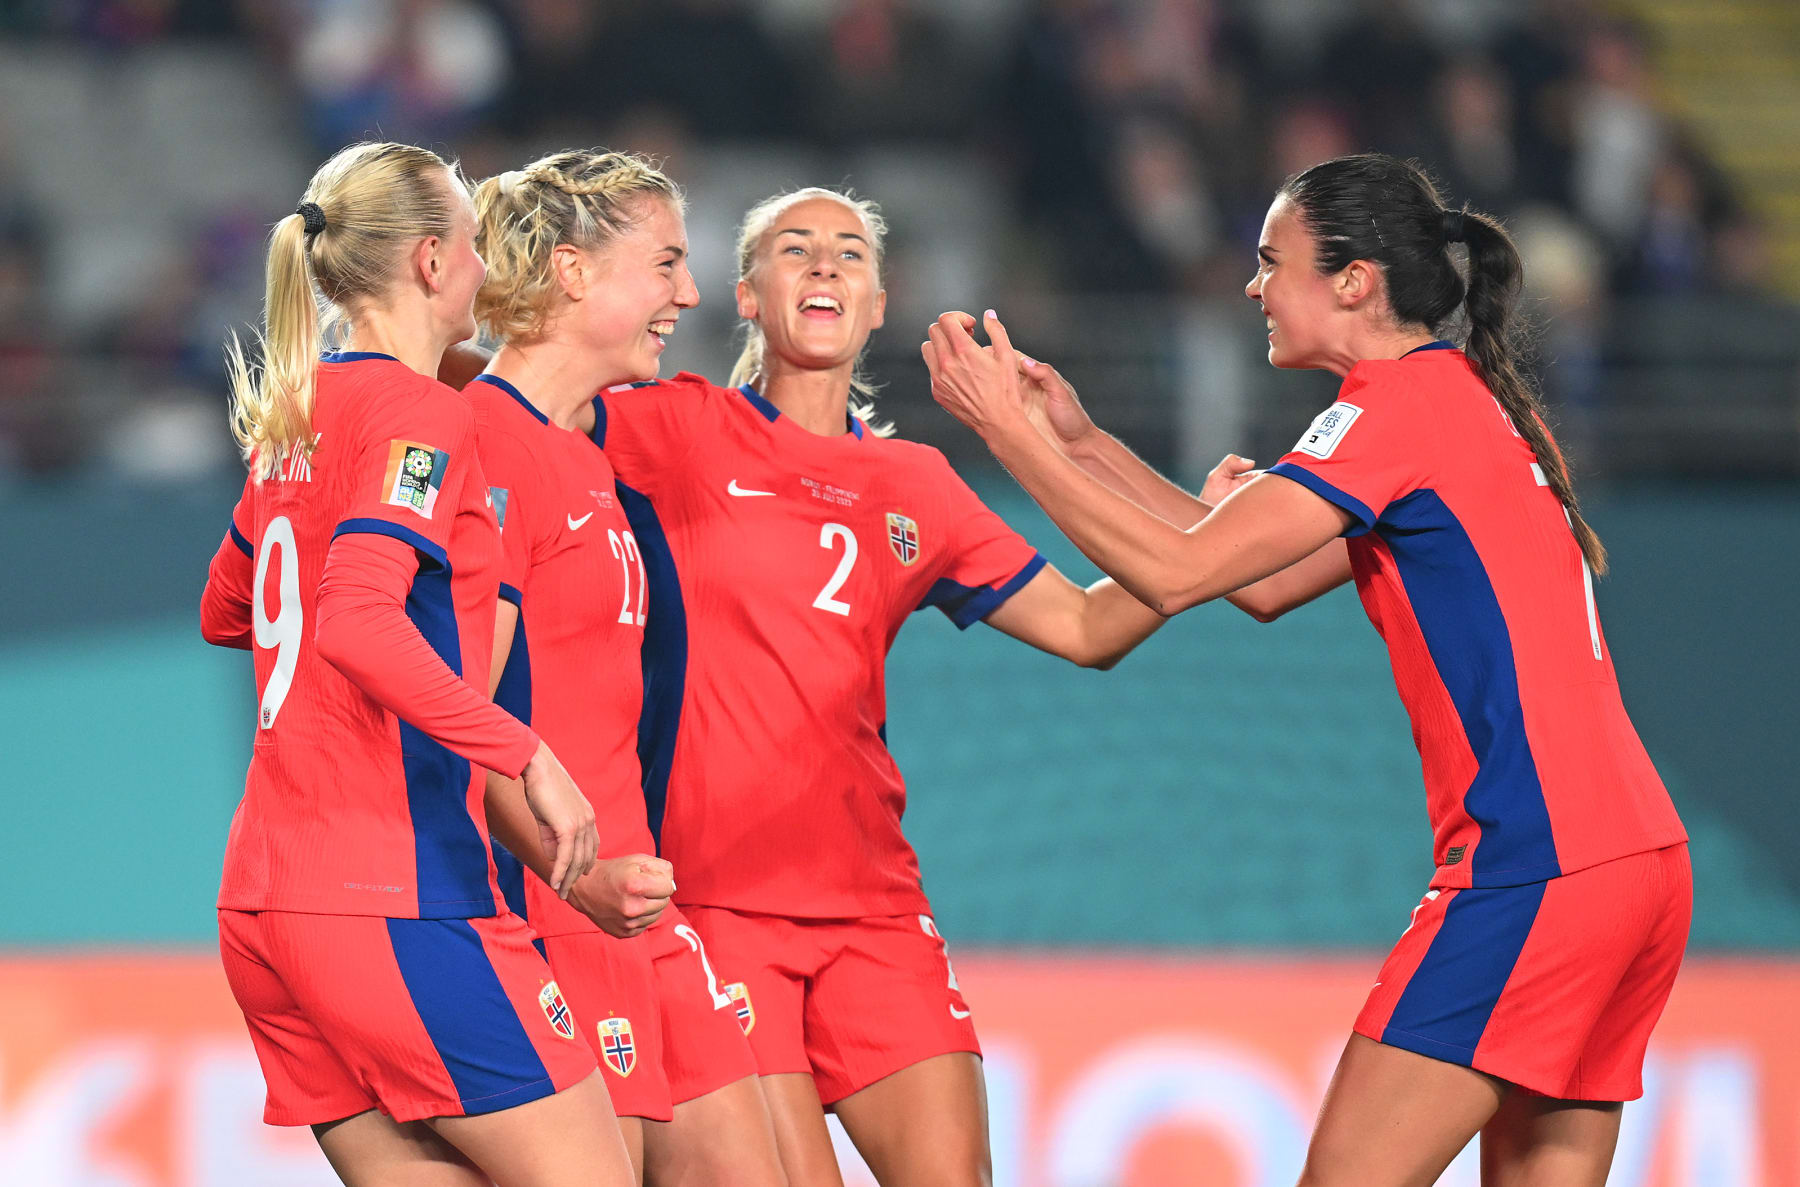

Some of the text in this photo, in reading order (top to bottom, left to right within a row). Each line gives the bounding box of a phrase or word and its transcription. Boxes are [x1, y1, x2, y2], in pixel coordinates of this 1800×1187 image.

[607, 528, 646, 627] 22
[812, 522, 858, 617] 2
[254, 516, 303, 729] 9
